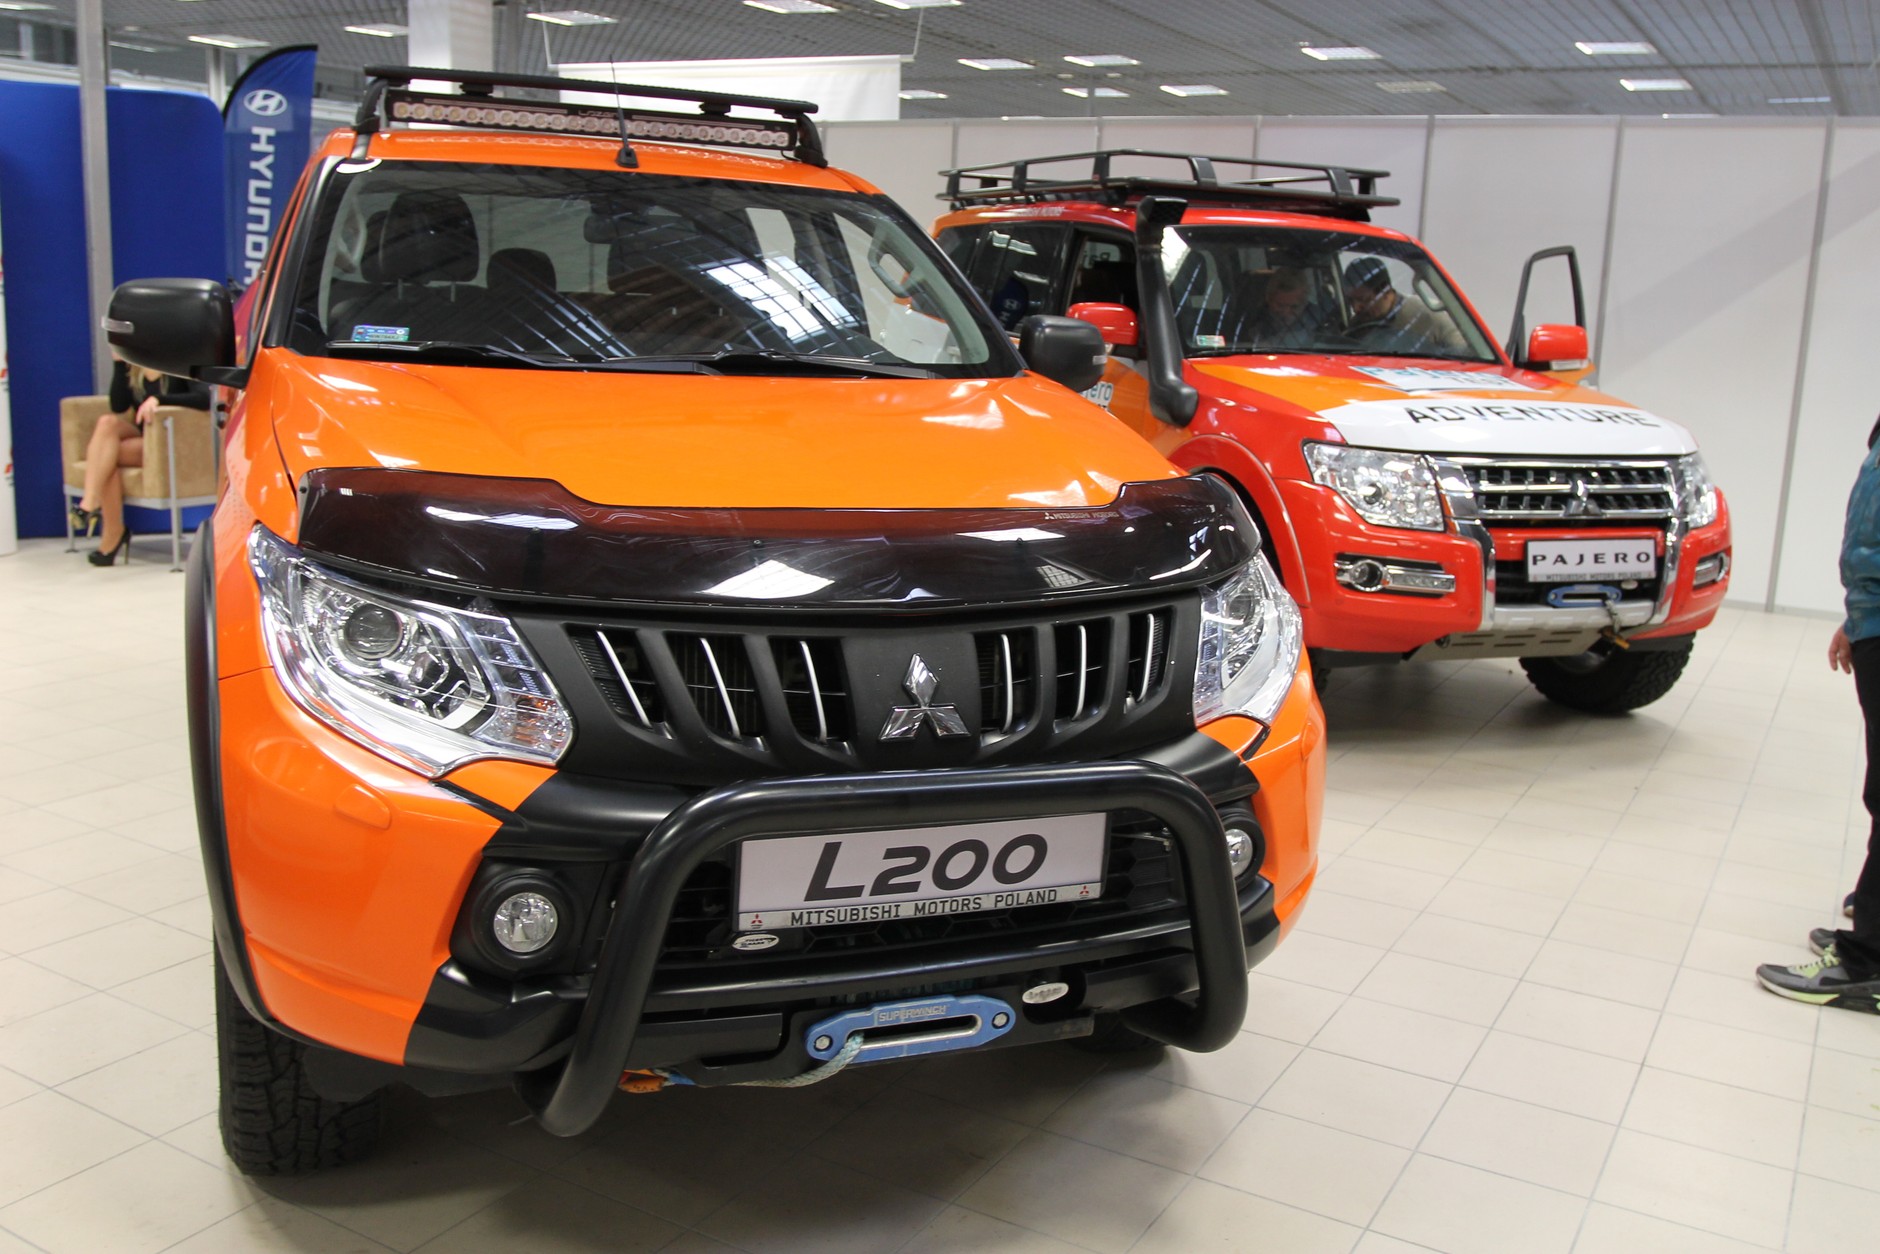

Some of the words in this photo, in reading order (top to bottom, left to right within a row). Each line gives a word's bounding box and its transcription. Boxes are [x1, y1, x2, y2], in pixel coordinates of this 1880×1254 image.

[1404, 406, 1661, 427] ADVENTURE
[1532, 551, 1651, 566] PAJERO
[803, 833, 1048, 902] L200
[790, 904, 901, 927] MITSUBISHI
[914, 897, 982, 917] MOTORS
[993, 889, 1058, 908] POLAND
[879, 1005, 947, 1022] SUPERWINCH
